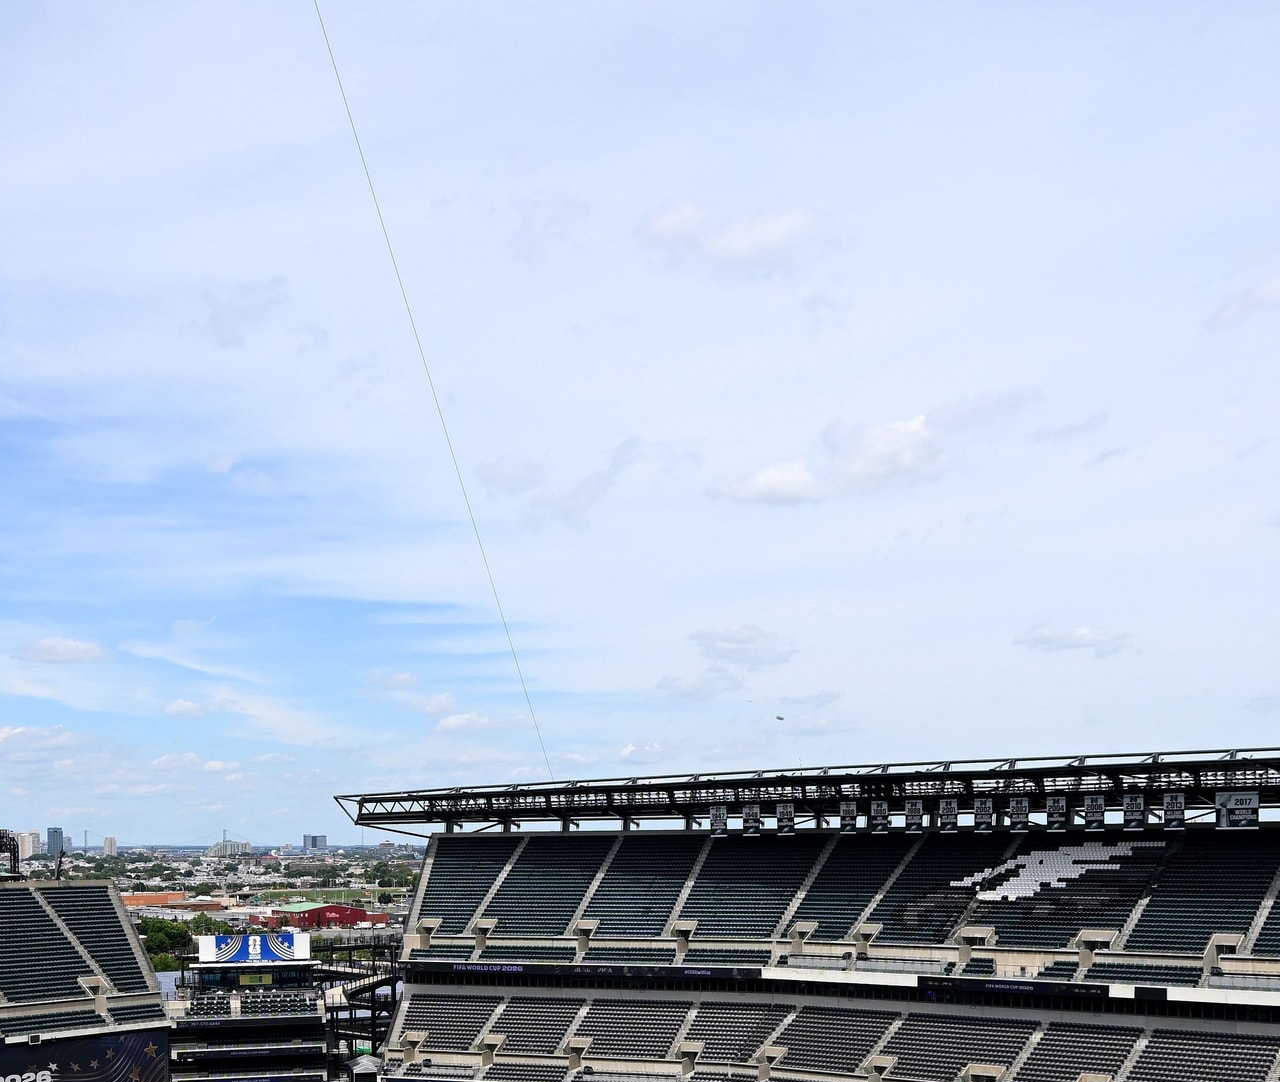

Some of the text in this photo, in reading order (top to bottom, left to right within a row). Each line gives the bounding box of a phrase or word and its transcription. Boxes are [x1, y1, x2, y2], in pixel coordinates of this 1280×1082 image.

[1234, 798, 1252, 806] 2017
[1048, 804, 1064, 812] 2004
[1086, 803, 1102, 811] 2006
